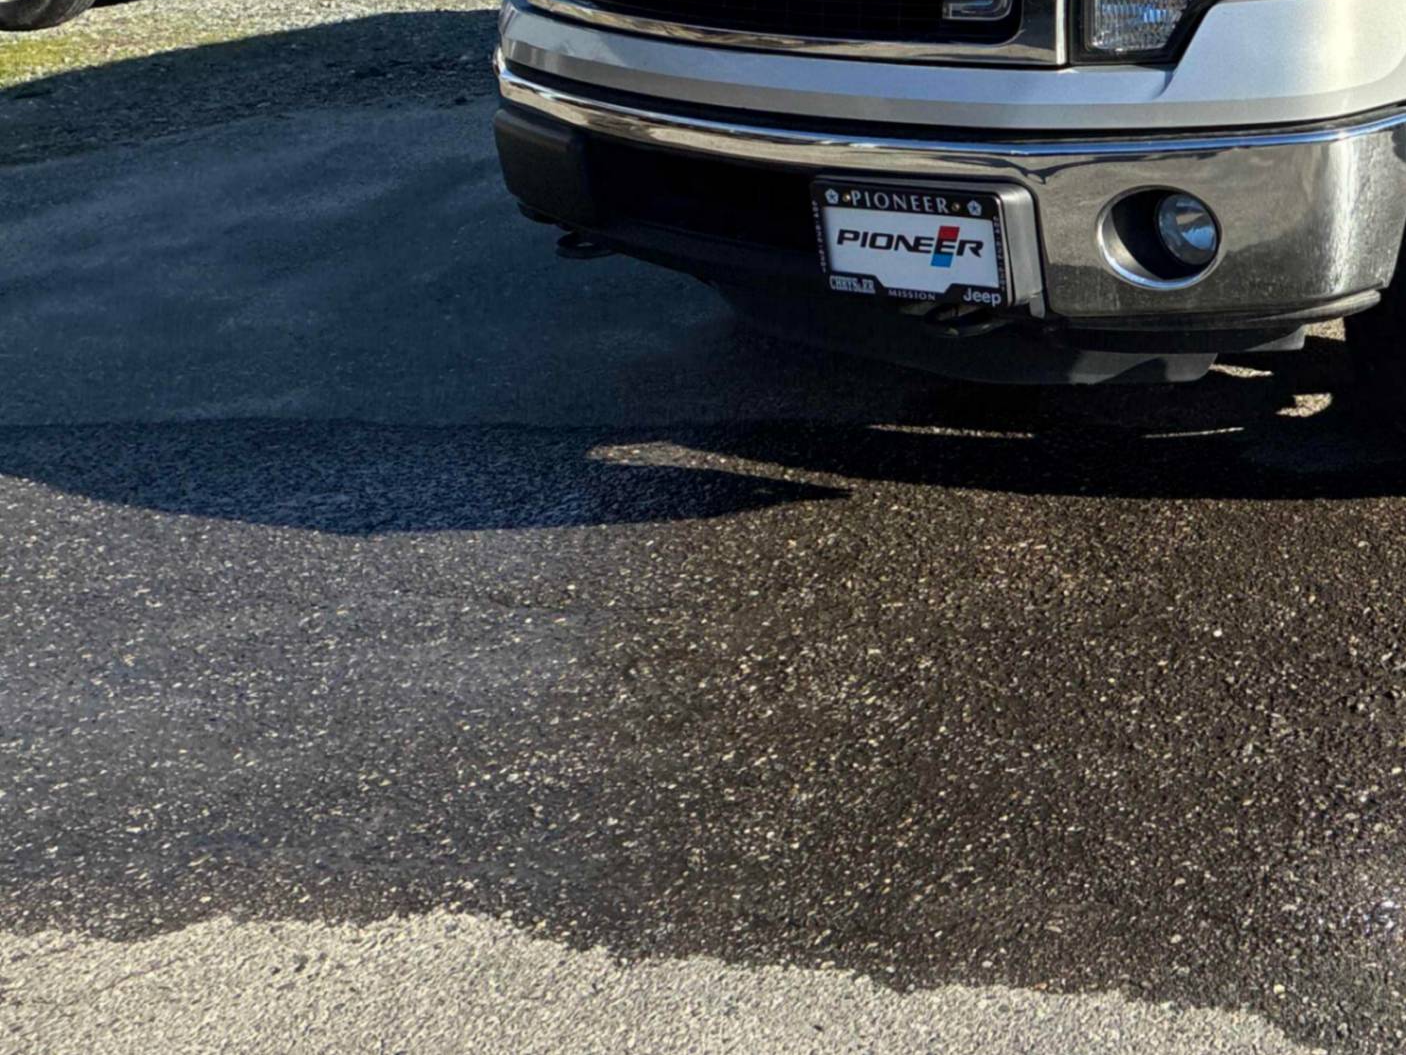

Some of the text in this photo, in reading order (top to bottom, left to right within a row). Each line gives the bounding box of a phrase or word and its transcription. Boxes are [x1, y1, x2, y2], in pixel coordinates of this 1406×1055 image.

[850, 190, 950, 214] PIONEER
[836, 228, 984, 258] PIONEER
[829, 274, 876, 294] CHRYSLER
[888, 288, 936, 301] MISSION
[963, 288, 1002, 307] Jeep
